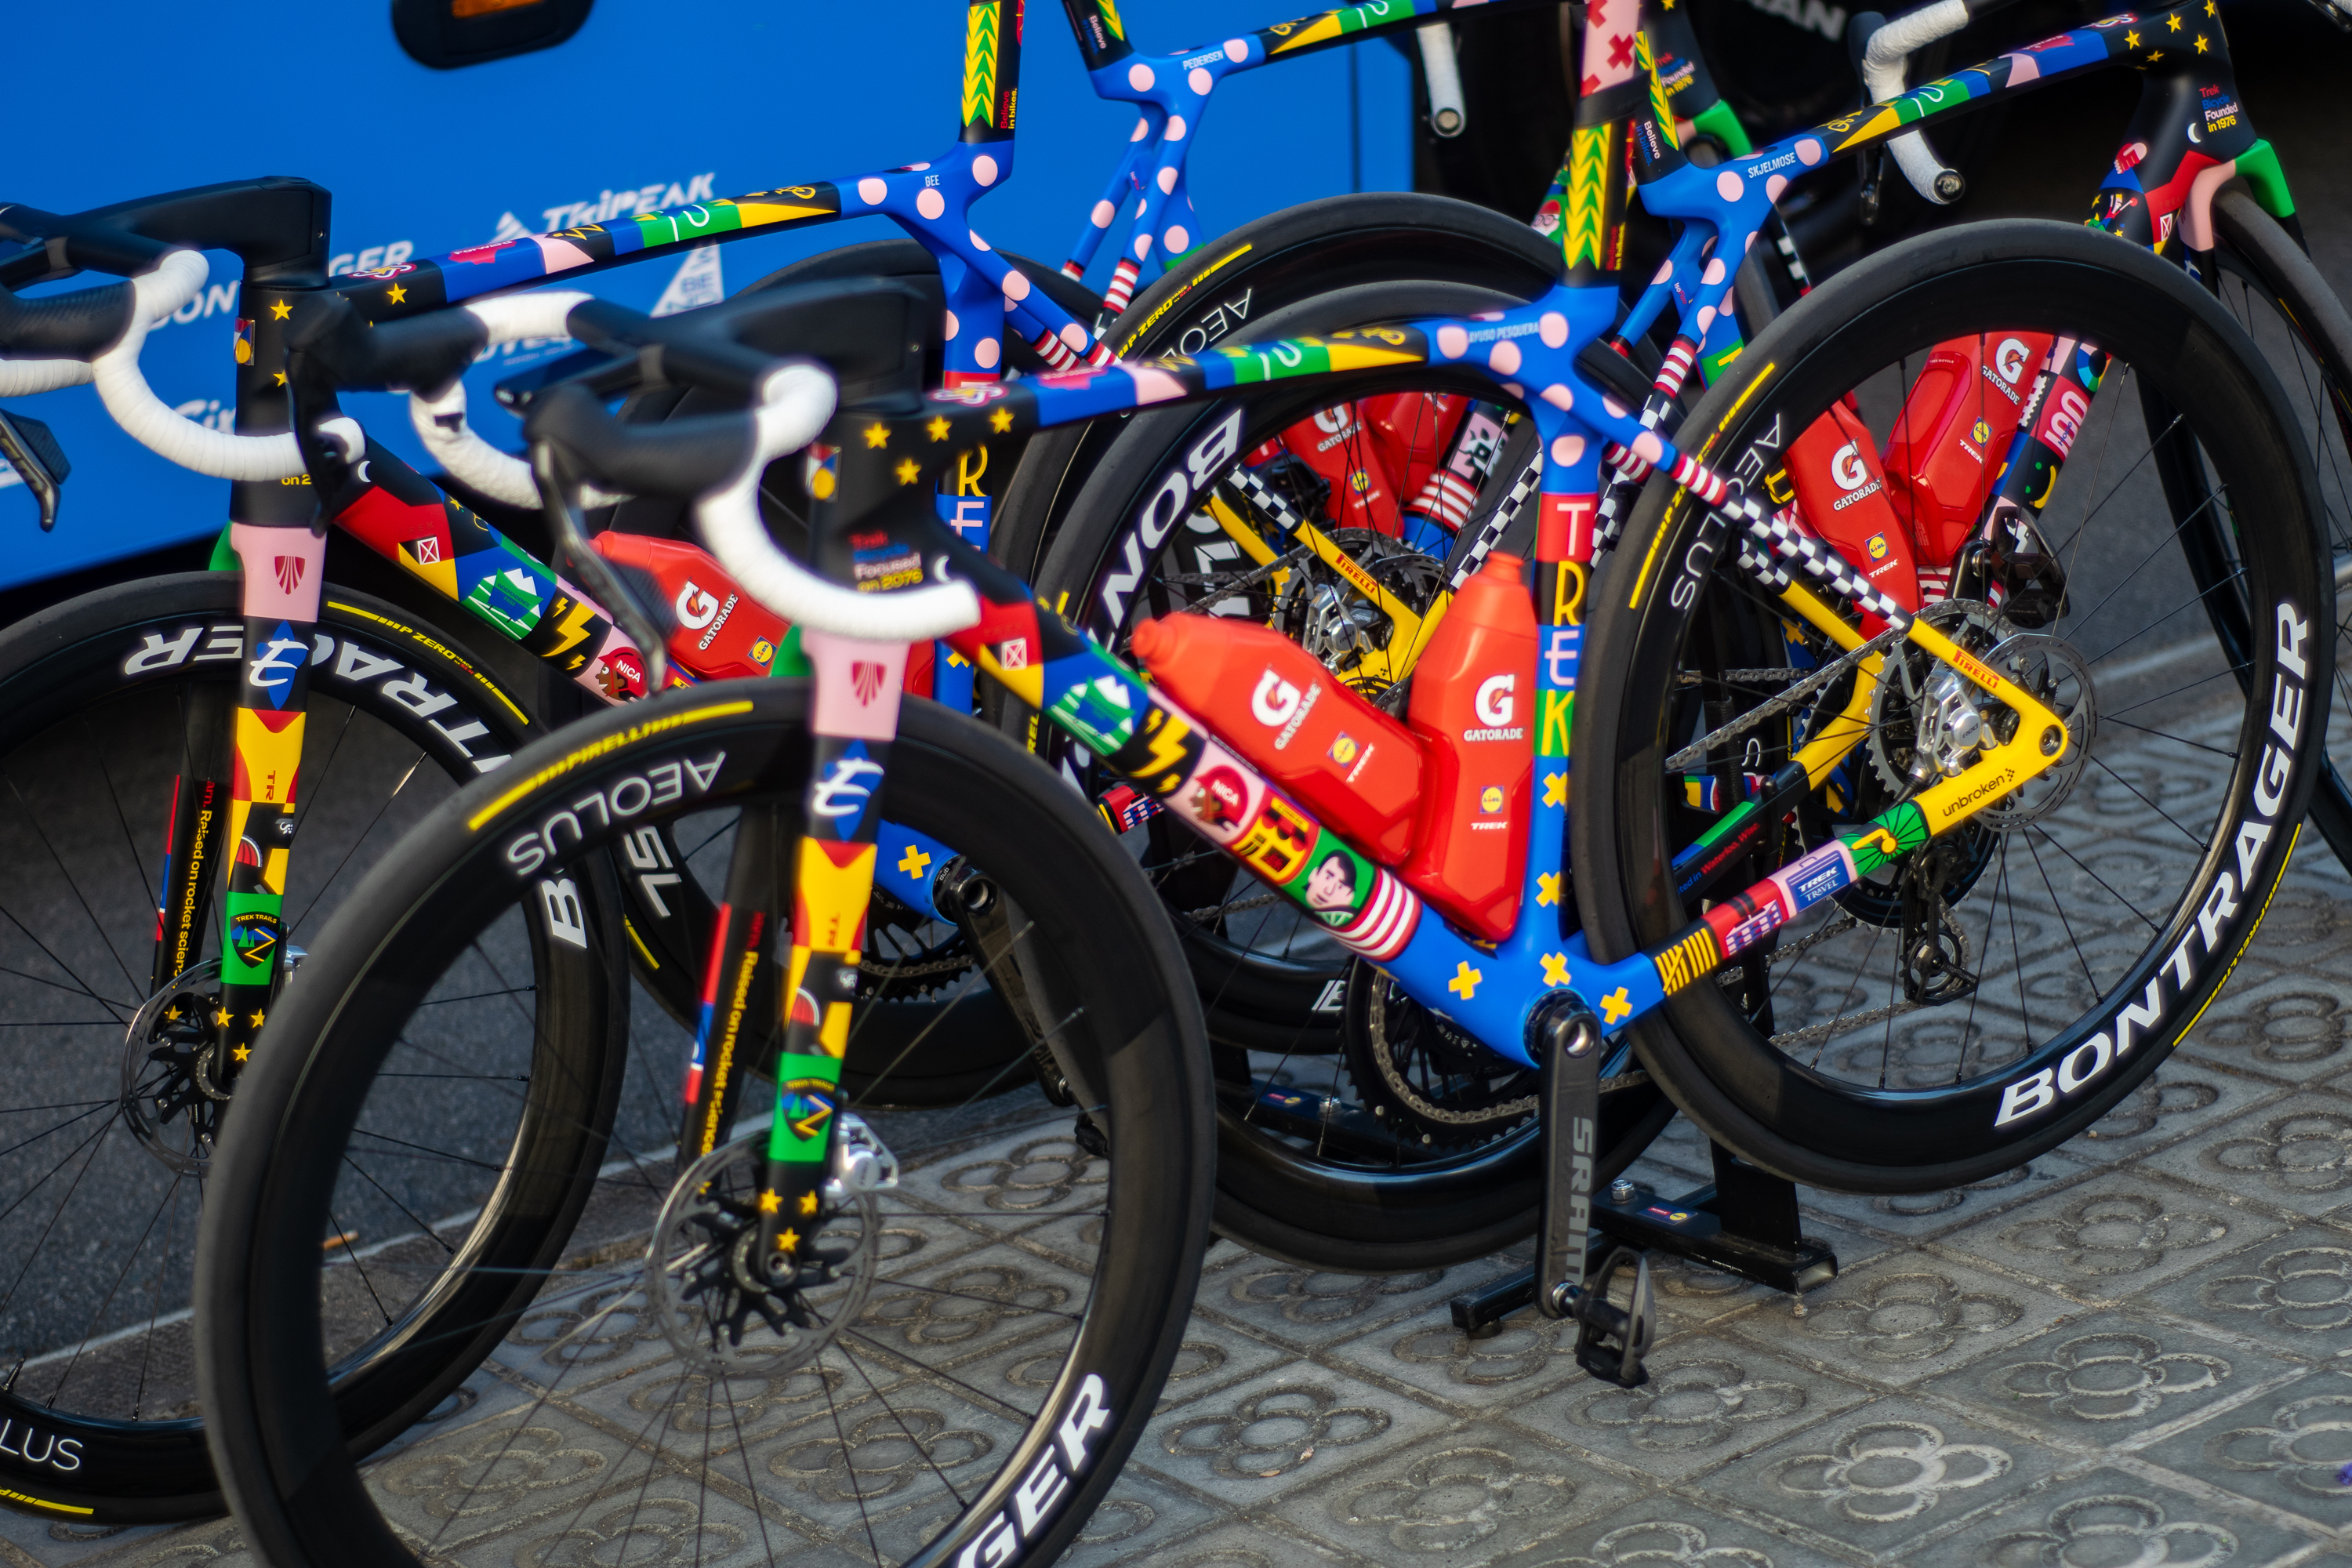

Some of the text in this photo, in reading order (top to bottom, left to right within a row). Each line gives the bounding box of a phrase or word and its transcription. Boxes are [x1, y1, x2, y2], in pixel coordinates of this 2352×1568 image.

[1089, 15, 1107, 49] Believe
[1182, 49, 1224, 70] PEDERSEN
[1661, 61, 1696, 87] Founded
[2200, 84, 2220, 98] Trek
[2202, 93, 2230, 110] Bicycle
[1000, 91, 1009, 129] Believe
[1008, 88, 1018, 129] in bikes.
[2205, 102, 2238, 121] Founded
[2208, 115, 2236, 132] in 1976
[1644, 121, 1661, 159] Believe
[1748, 152, 1796, 179] SKJELMOSE
[924, 174, 941, 187] GEE
[1128, 299, 1173, 348] P ZERO
[1981, 365, 2021, 405] GATORADE
[1318, 420, 1363, 452] GATORADE
[2058, 421, 2073, 447] Hope
[1959, 438, 1984, 464] TREK
[281, 476, 299, 485] on
[1833, 477, 1882, 511] GATORADE
[1353, 491, 1381, 510] TREK
[1334, 553, 1377, 593] PIRELLI
[1869, 558, 1898, 579] TREK
[497, 583, 531, 608] INDEPENDENCE
[699, 593, 739, 651] GATORADE
[1539, 503, 1592, 757] TREK
[412, 632, 456, 659] ZERO
[616, 659, 641, 683] NICA
[1953, 649, 2000, 689] PIRELLI
[1275, 684, 1322, 750] GATORADE
[568, 722, 647, 768] PIRELLI
[1464, 727, 1524, 743] GATORADE
[1211, 779, 1239, 806] NICA
[1942, 774, 2005, 817] unbroken
[506, 751, 726, 876] AEOLUS
[1471, 821, 1508, 831] TREK
[194, 810, 212, 859] Raised
[191, 861, 200, 880] on
[1693, 872, 1702, 882] in
[1700, 841, 1740, 874] Waterloo,
[1994, 602, 2307, 1127] BONTRAGER
[1798, 866, 1837, 892] TREK
[1805, 880, 1838, 902] TRAVEL
[181, 882, 195, 930] rocket
[236, 913, 278, 924] TREK TRAILS
[2227, 908, 2265, 977] PIRELLI
[733, 951, 759, 1010] Raised
[730, 1010, 742, 1030] on
[714, 1030, 735, 1088] rocket
[702, 1089, 723, 1156] science
